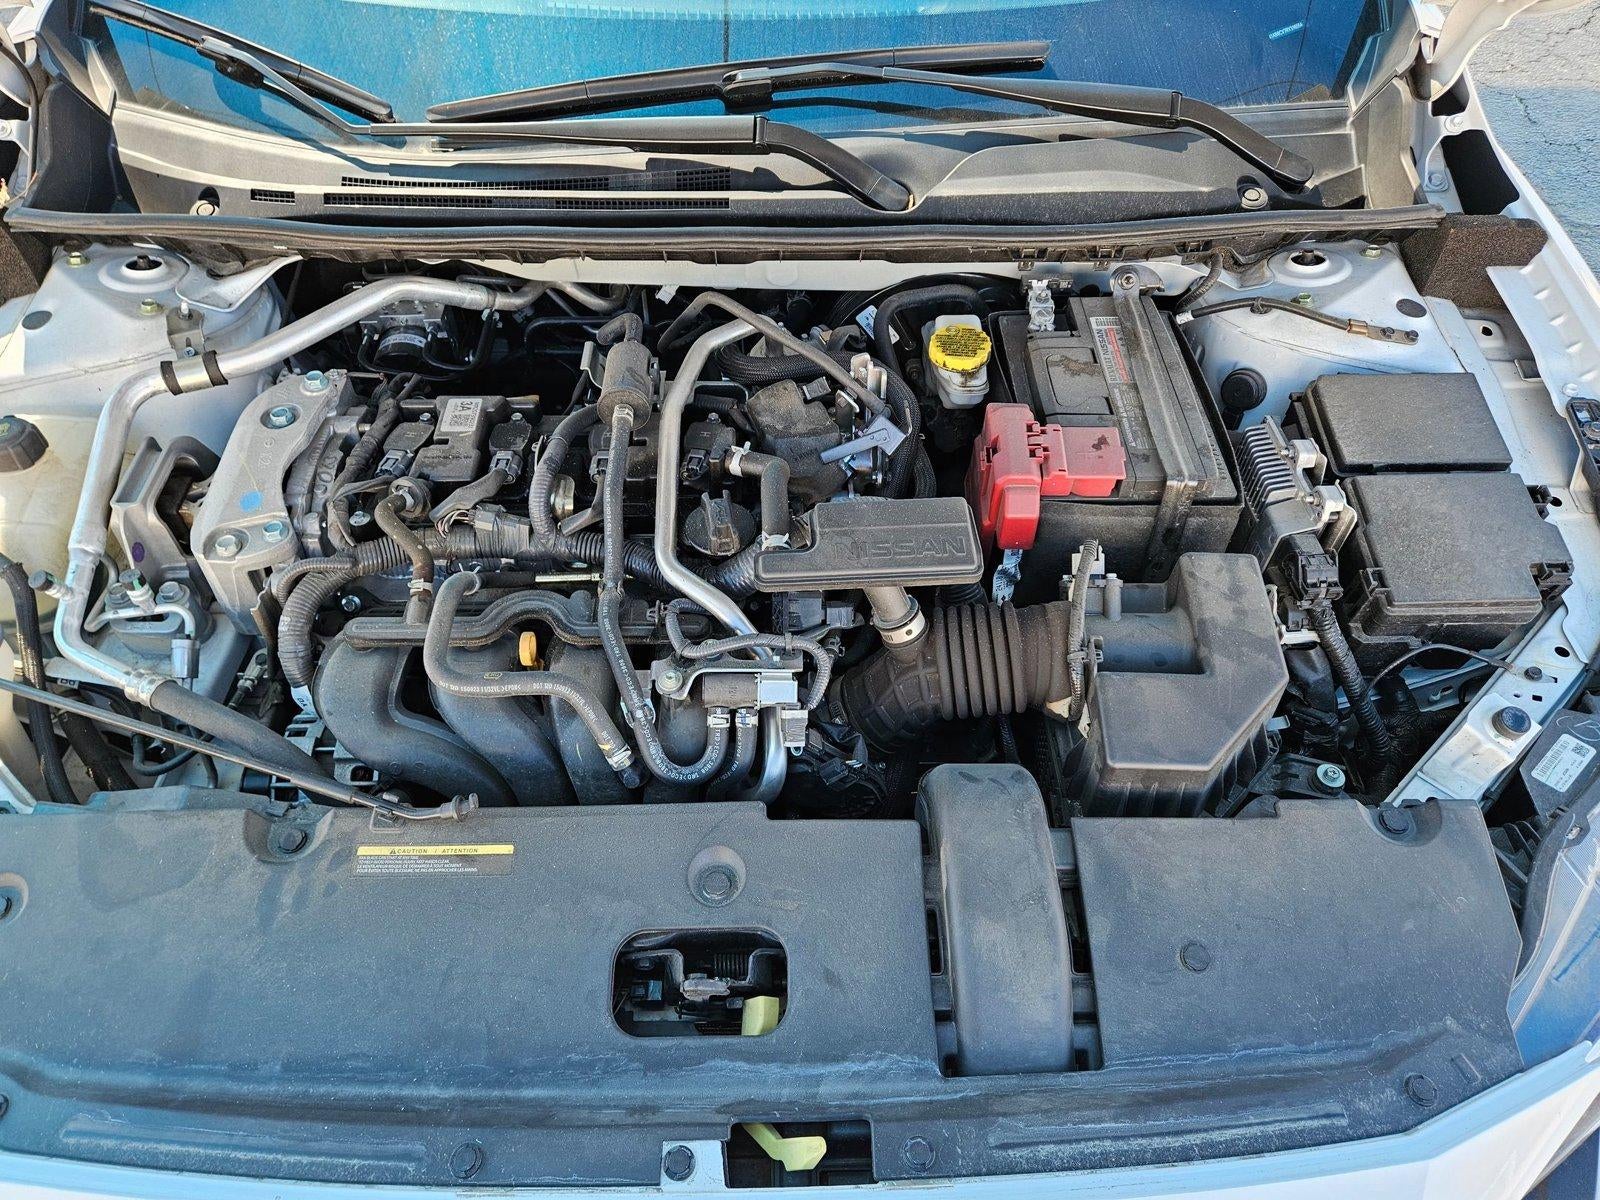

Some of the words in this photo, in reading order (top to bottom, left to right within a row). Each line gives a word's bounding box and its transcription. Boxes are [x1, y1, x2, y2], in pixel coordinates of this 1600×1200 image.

[1096, 329, 1109, 356] NISSAN
[459, 401, 473, 411] 3A
[834, 536, 967, 560] NISSAN
